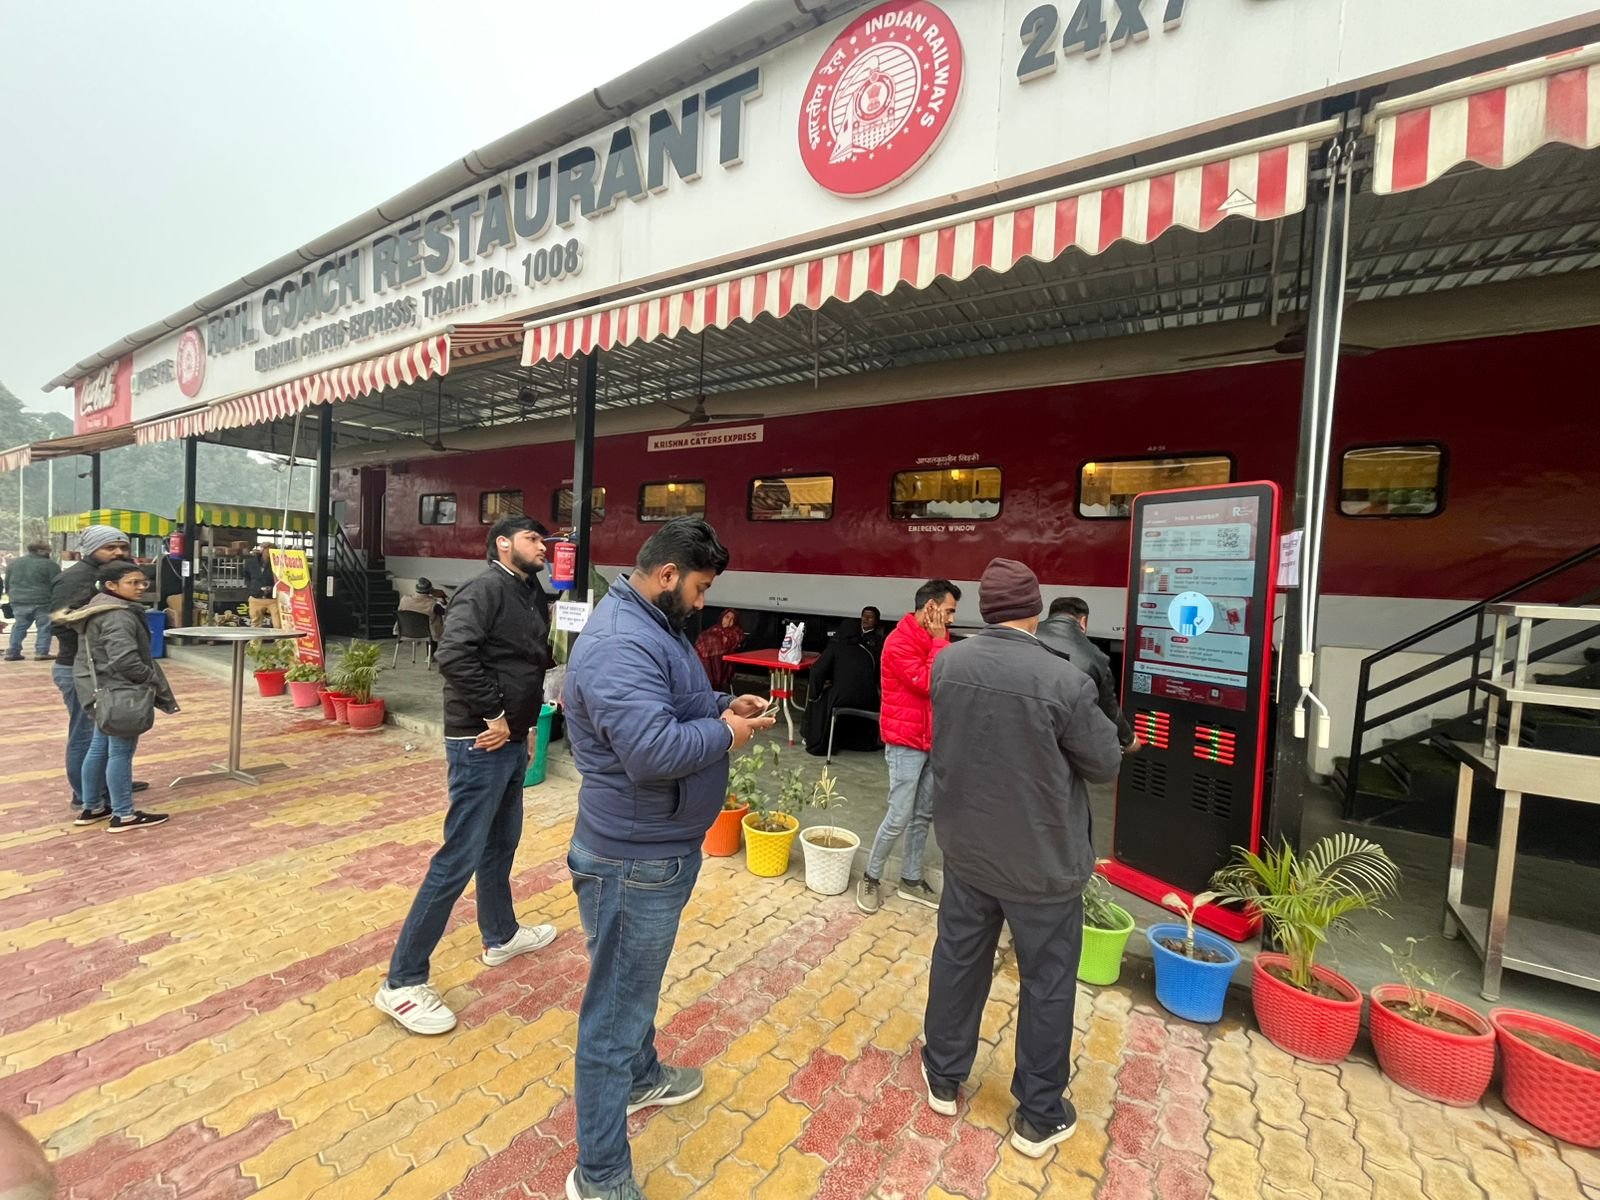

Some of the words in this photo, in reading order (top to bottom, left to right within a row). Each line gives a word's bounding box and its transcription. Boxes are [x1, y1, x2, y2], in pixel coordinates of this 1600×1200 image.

[806, 83, 827, 150] भारतीय
[819, 48, 846, 75] रेल
[865, 10, 927, 36] INDIAN
[920, 24, 950, 128] RAILWAYS
[262, 248, 361, 336] COACH
[373, 66, 761, 294] RESTAURANT
[422, 273, 474, 317] TRAIN
[522, 238, 579, 286] 1008
[654, 439, 689, 449] KRISHNA
[690, 435, 722, 446] CATERS
[723, 432, 757, 443] EXPRESS
